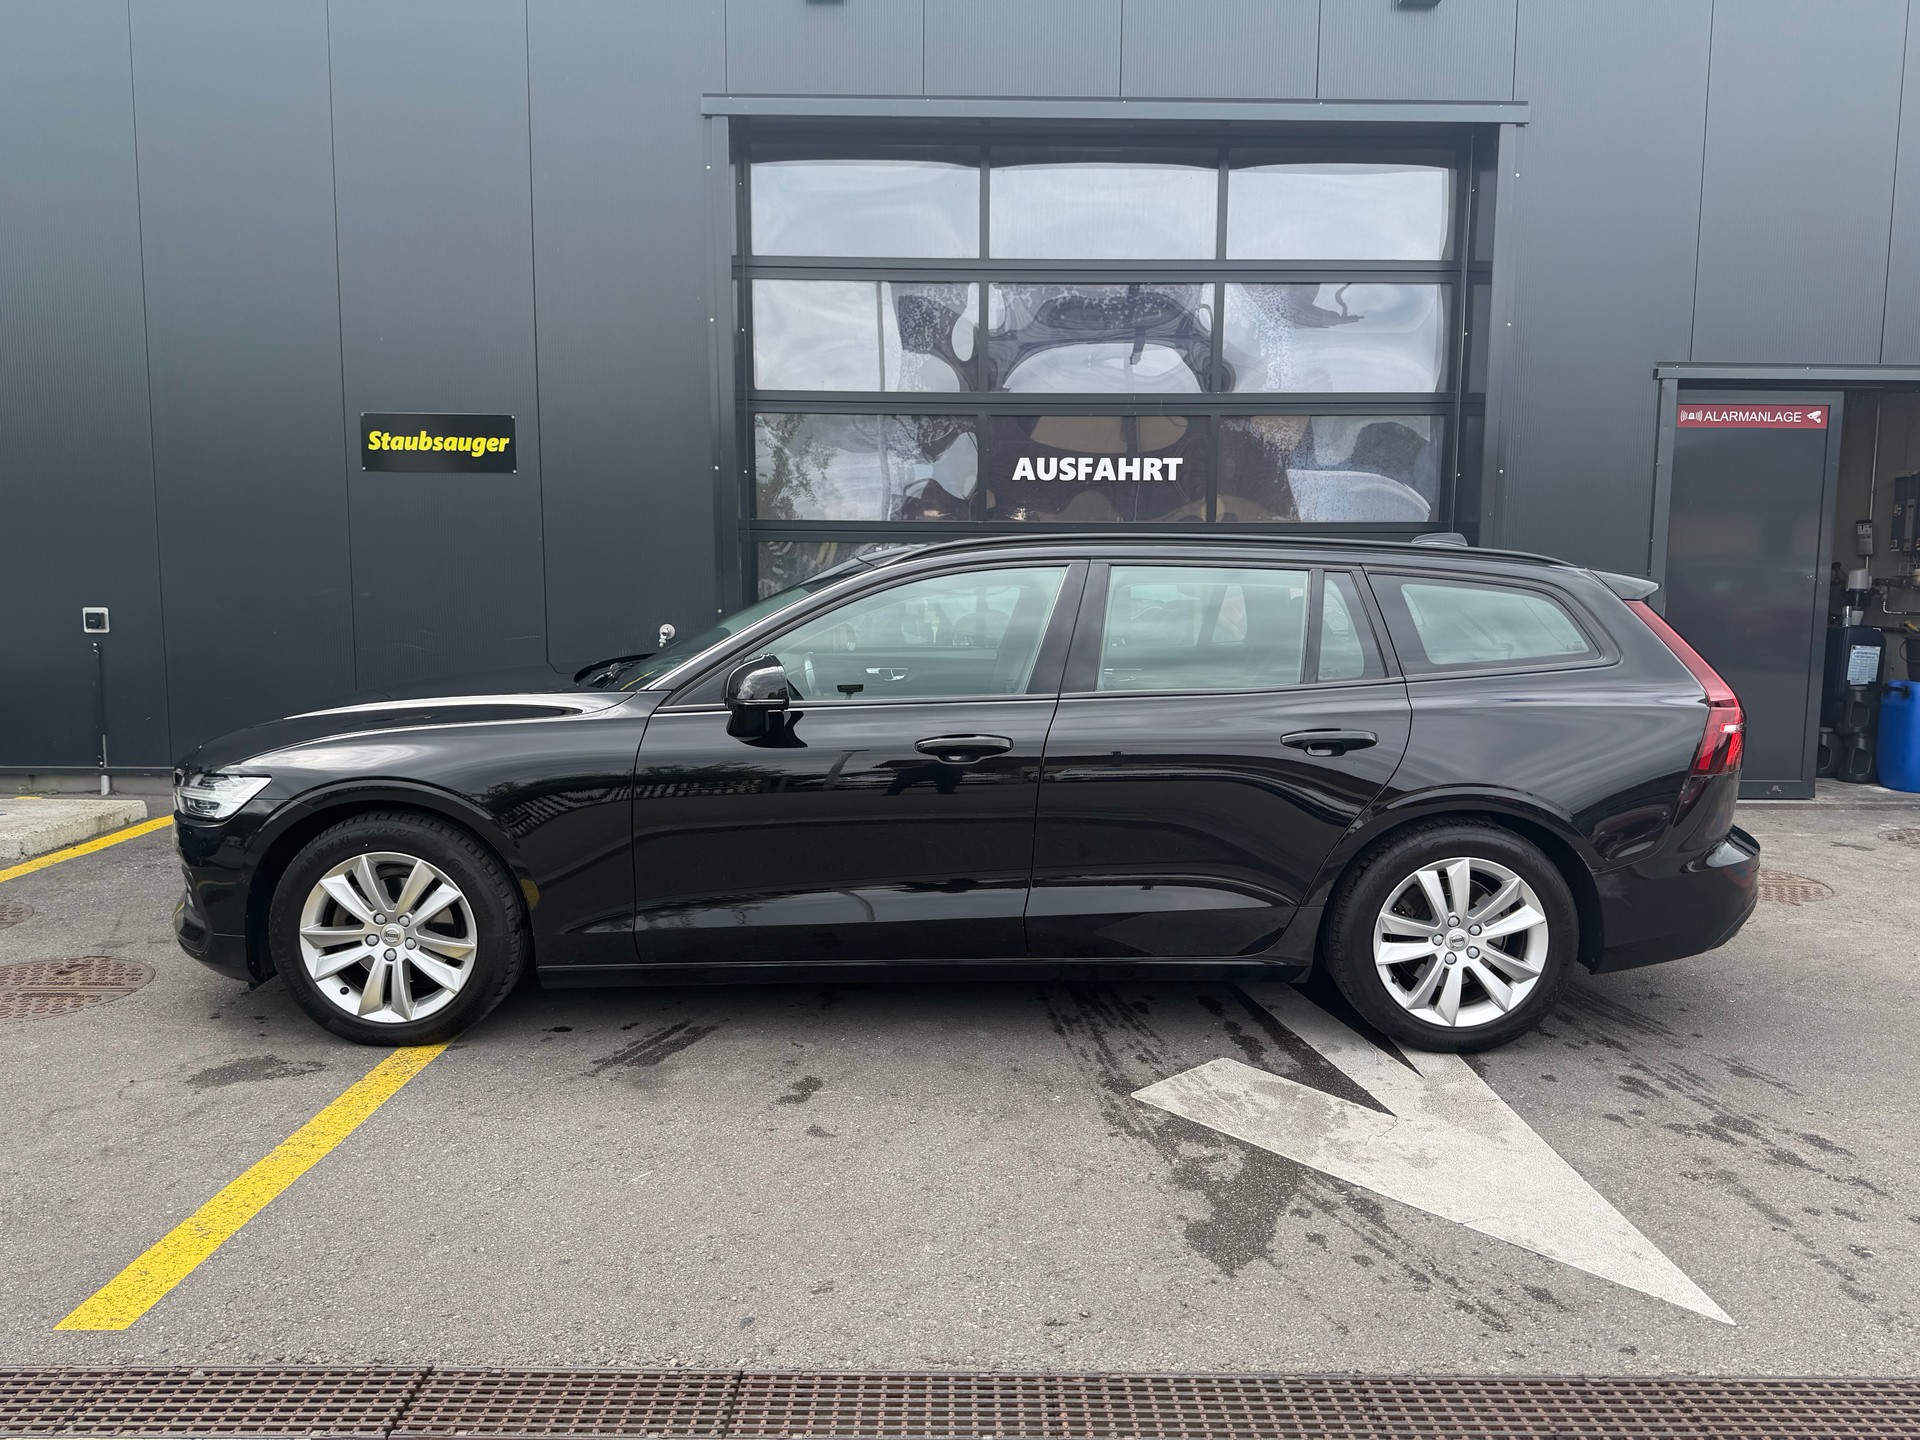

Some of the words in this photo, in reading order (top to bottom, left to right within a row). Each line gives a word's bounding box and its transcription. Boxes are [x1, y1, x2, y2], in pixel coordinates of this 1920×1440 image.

[1703, 411, 1802, 422] ALARMANLAGE
[368, 430, 510, 457] Staubsauger
[1012, 457, 1183, 481] AUSFAHRT
